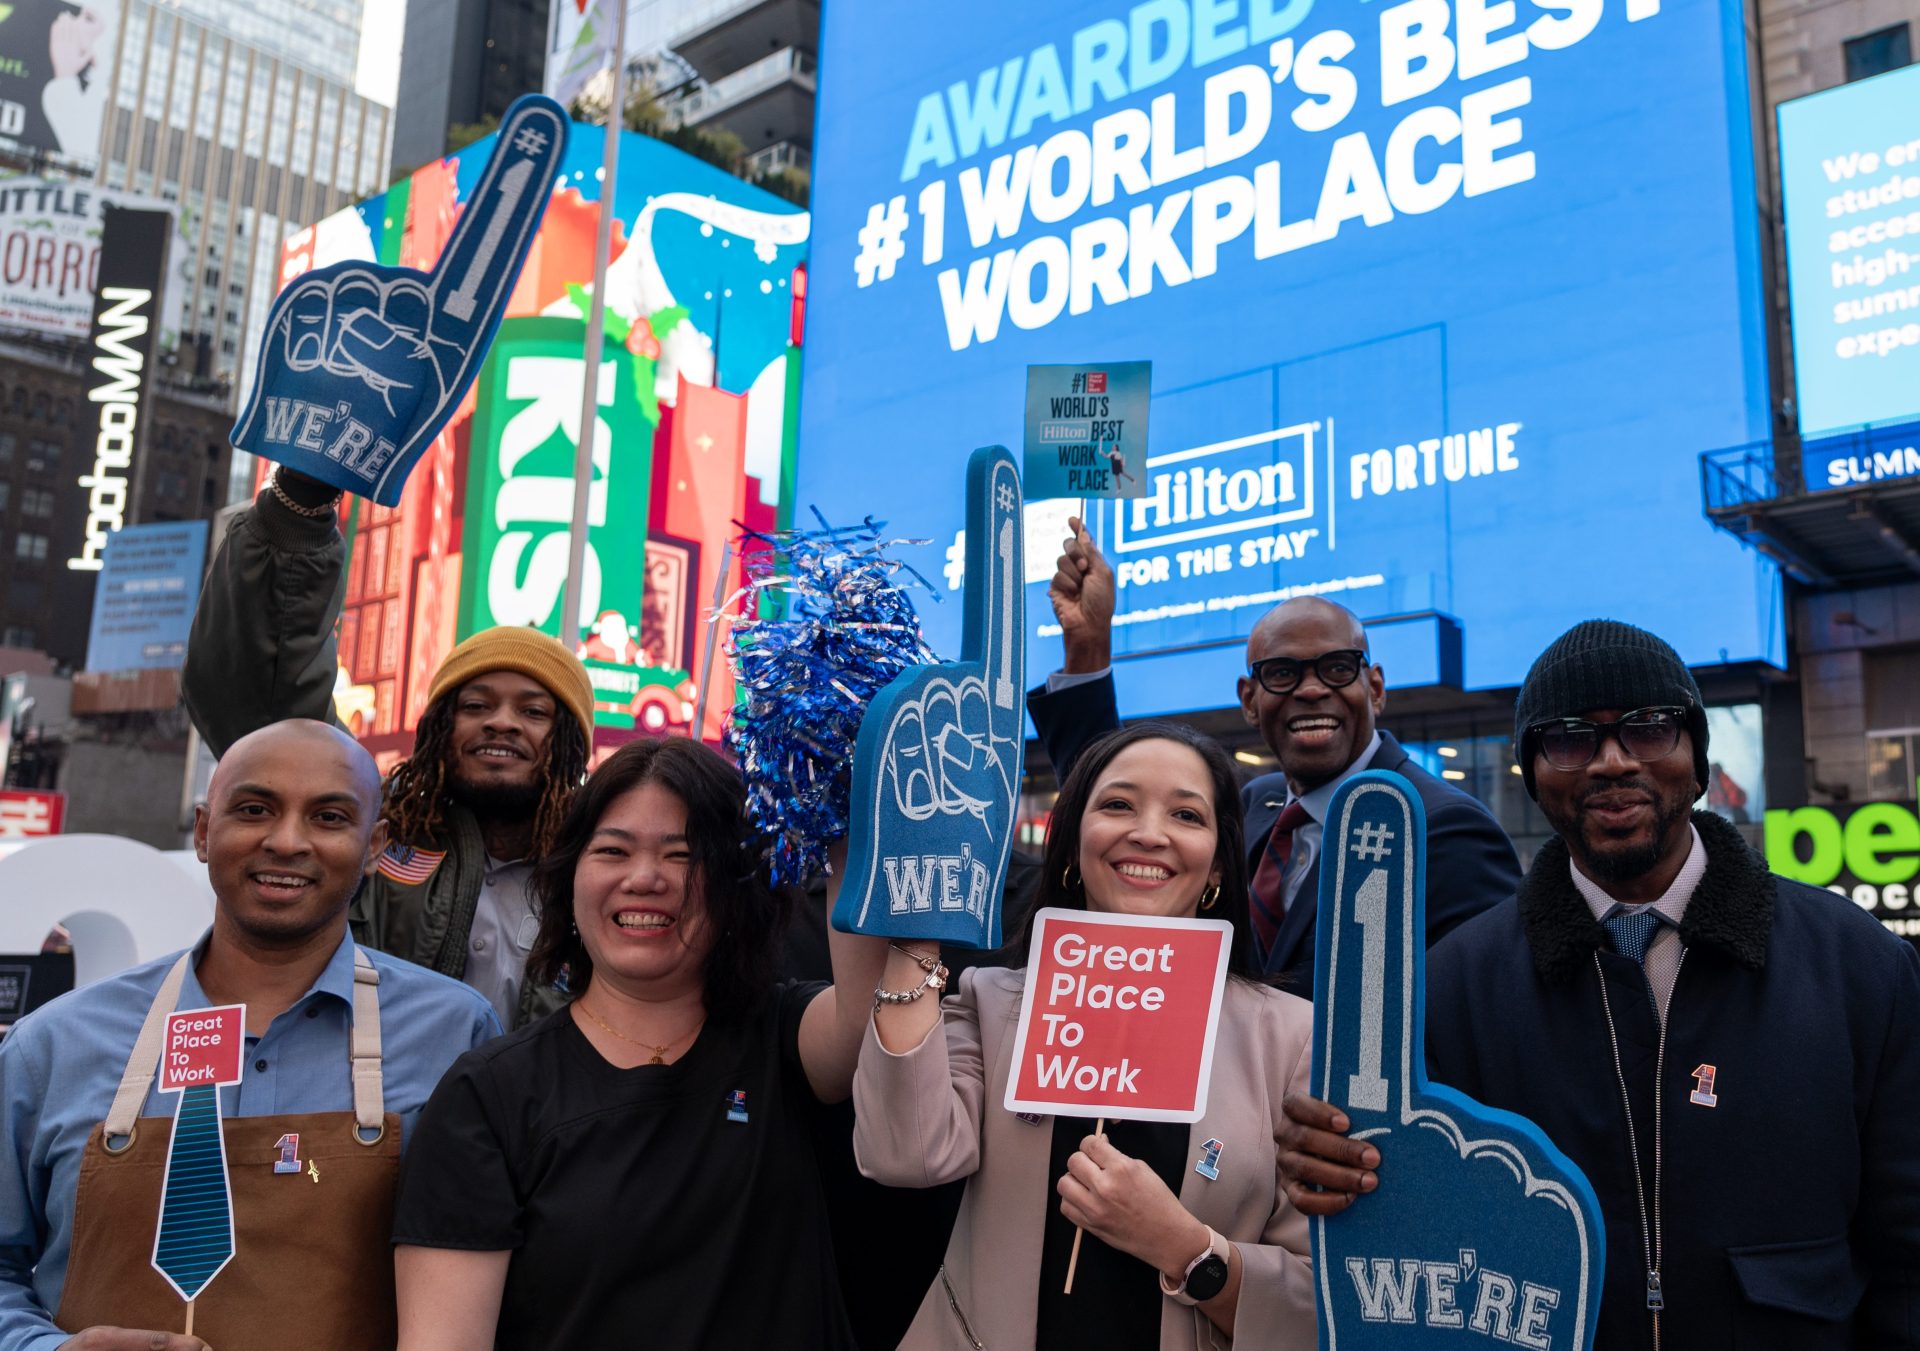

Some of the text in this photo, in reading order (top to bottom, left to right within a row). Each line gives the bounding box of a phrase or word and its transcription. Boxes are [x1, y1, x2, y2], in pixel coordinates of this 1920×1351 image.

[958, 30, 1358, 248] WORLD'S
[1380, 0, 1661, 106] BES
[1822, 151, 1880, 182] We
[937, 75, 1536, 352] WORKPLACE
[1050, 396, 1110, 419] WORLD'S
[264, 397, 398, 484] WE'RE
[1043, 420, 1125, 442] Hilton BEST
[1058, 445, 1097, 467] WORK
[1350, 424, 1521, 500] FORTUNE
[1068, 469, 1110, 491] PLACE
[1130, 461, 1296, 532] Hilton
[1117, 528, 1311, 589] FOR THE STAY
[1764, 776, 1920, 887] pe
[1826, 884, 1920, 911] OC
[1053, 933, 1175, 974] Great
[1048, 972, 1165, 1011] Place
[172, 1015, 223, 1034] Great
[172, 1034, 222, 1050] Place
[1042, 1013, 1084, 1048] To
[169, 1064, 215, 1083] Work
[170, 1052, 190, 1066] To
[1035, 1053, 1142, 1094] Work
[1346, 1248, 1561, 1351] WE'RE
